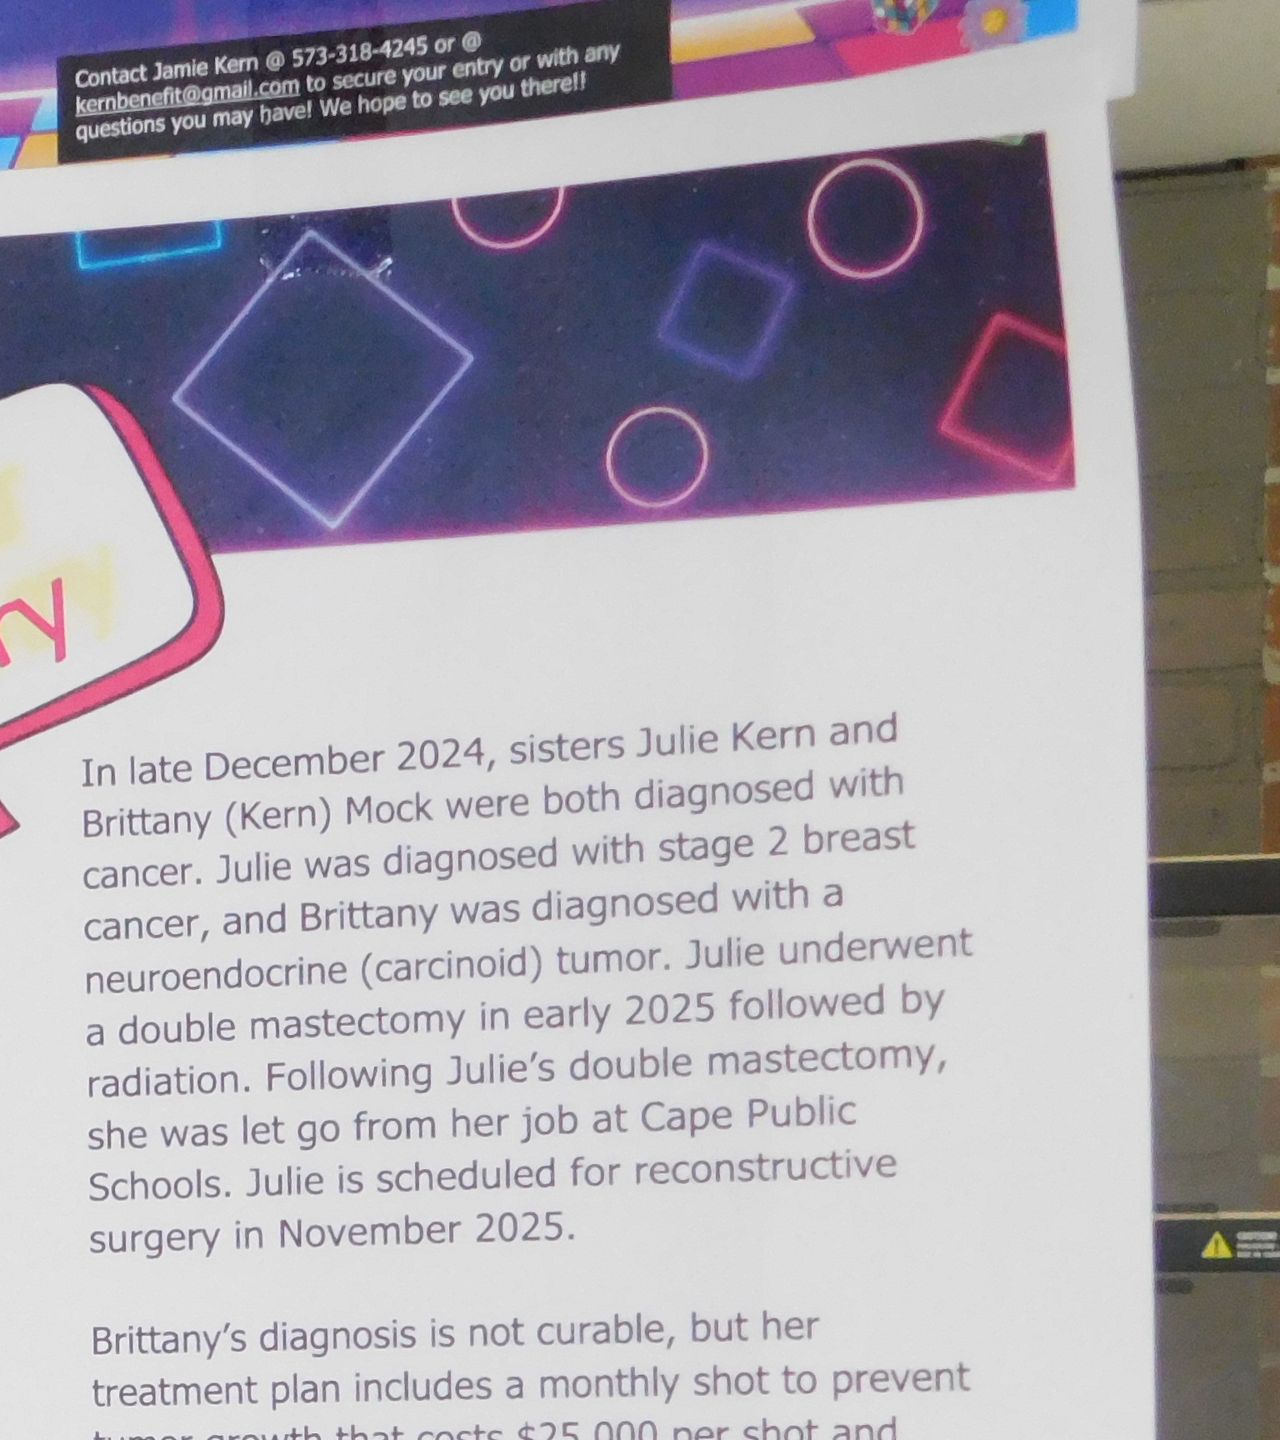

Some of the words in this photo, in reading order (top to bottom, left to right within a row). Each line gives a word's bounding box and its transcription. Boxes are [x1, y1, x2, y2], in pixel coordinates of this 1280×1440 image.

[75, 64, 147, 88] Contact
[153, 59, 208, 80] Jamie
[215, 55, 258, 75] Kern
[292, 35, 428, 67] 573-318-4245
[434, 37, 456, 54] or
[75, 79, 300, 117] kernbenefit@gmail.com
[306, 75, 326, 93] to
[333, 69, 396, 90] secure
[402, 65, 447, 87] your
[453, 58, 504, 78] entry
[510, 55, 531, 72] or
[537, 45, 579, 68] with
[584, 44, 621, 64] any
[76, 117, 165, 143] questions
[171, 114, 206, 135] you
[213, 110, 253, 128] may
[260, 100, 312, 125] have!
[320, 97, 351, 117] We
[358, 95, 406, 114] hope
[412, 90, 432, 108] to
[439, 89, 473, 106] see
[479, 84, 514, 106] you
[521, 71, 586, 97] there!!
[82, 759, 115, 787] In
[130, 756, 192, 784] late
[206, 744, 385, 781] December
[398, 737, 495, 772] 2024,
[510, 734, 624, 764] sisters
[637, 725, 718, 757] Julie
[733, 721, 815, 751] Kern
[830, 712, 897, 745] and
[84, 808, 211, 840] Brittany
[226, 797, 330, 838] (Kern)
[347, 792, 433, 824] Mock
[446, 794, 529, 819] were
[544, 781, 619, 814] both
[635, 770, 813, 814] diagnosed
[830, 765, 903, 798] with
[83, 864, 201, 889] cancer.
[217, 852, 291, 883] Julie
[305, 855, 370, 879] was
[384, 837, 557, 881] diagnosed
[572, 833, 643, 865] with
[659, 833, 753, 867] stage
[769, 826, 787, 855] 2
[804, 820, 916, 854] breast
[84, 915, 209, 943] cancer,
[223, 903, 286, 935] and
[301, 901, 438, 934] Brittany
[451, 900, 520, 924] was
[532, 882, 717, 926] diagnosed
[732, 878, 808, 911] with
[823, 884, 843, 907] a
[86, 957, 347, 994] neuroendocrine
[362, 945, 541, 990] (carcinoid)
[557, 947, 669, 974] tumor.
[686, 937, 764, 969] Julie
[780, 928, 973, 965] underwent
[87, 1024, 104, 1046] a
[119, 1012, 235, 1045] double
[251, 1007, 465, 1039] mastectomy
[481, 1002, 509, 1030] in
[524, 997, 611, 1034] early
[626, 993, 714, 1024] 2025
[730, 984, 884, 1020] followed
[902, 983, 945, 1020] by
[89, 1066, 249, 1098] radiation.
[268, 1058, 431, 1093] Following
[447, 1052, 554, 1085] Julie’s
[570, 1047, 691, 1080] double
[709, 1042, 946, 1075] mastectomy,
[88, 1120, 147, 1150] she
[161, 1124, 228, 1147] was
[243, 1115, 285, 1144] let
[298, 1120, 340, 1150] go
[354, 1111, 435, 1140] from
[452, 1108, 509, 1137] her
[521, 1104, 577, 1143] job
[593, 1104, 628, 1133] at
[642, 1101, 732, 1138] Cape
[749, 1095, 856, 1128] Public
[89, 1169, 230, 1201] Schools.
[246, 1166, 323, 1197] Julie
[339, 1165, 363, 1193] is
[377, 1157, 555, 1193] scheduled
[571, 1156, 621, 1186] for
[636, 1149, 897, 1184] reconstructive
[90, 1228, 220, 1259] surgery
[236, 1220, 263, 1249] in
[280, 1215, 461, 1248] November
[477, 1211, 574, 1242] 2025.
[93, 1323, 246, 1360] Brittany’s
[260, 1319, 416, 1357] diagnosis
[431, 1318, 455, 1347] is
[470, 1318, 525, 1346] not
[537, 1313, 675, 1349] curable,
[692, 1312, 748, 1342] but
[763, 1310, 820, 1340] her
[92, 1376, 258, 1407] treatment
[272, 1373, 339, 1411] plan
[355, 1370, 492, 1402] includes
[506, 1377, 523, 1399] a
[541, 1366, 679, 1404] monthly
[694, 1365, 769, 1396] shot
[782, 1366, 817, 1394] to
[833, 1362, 971, 1401] prevent
